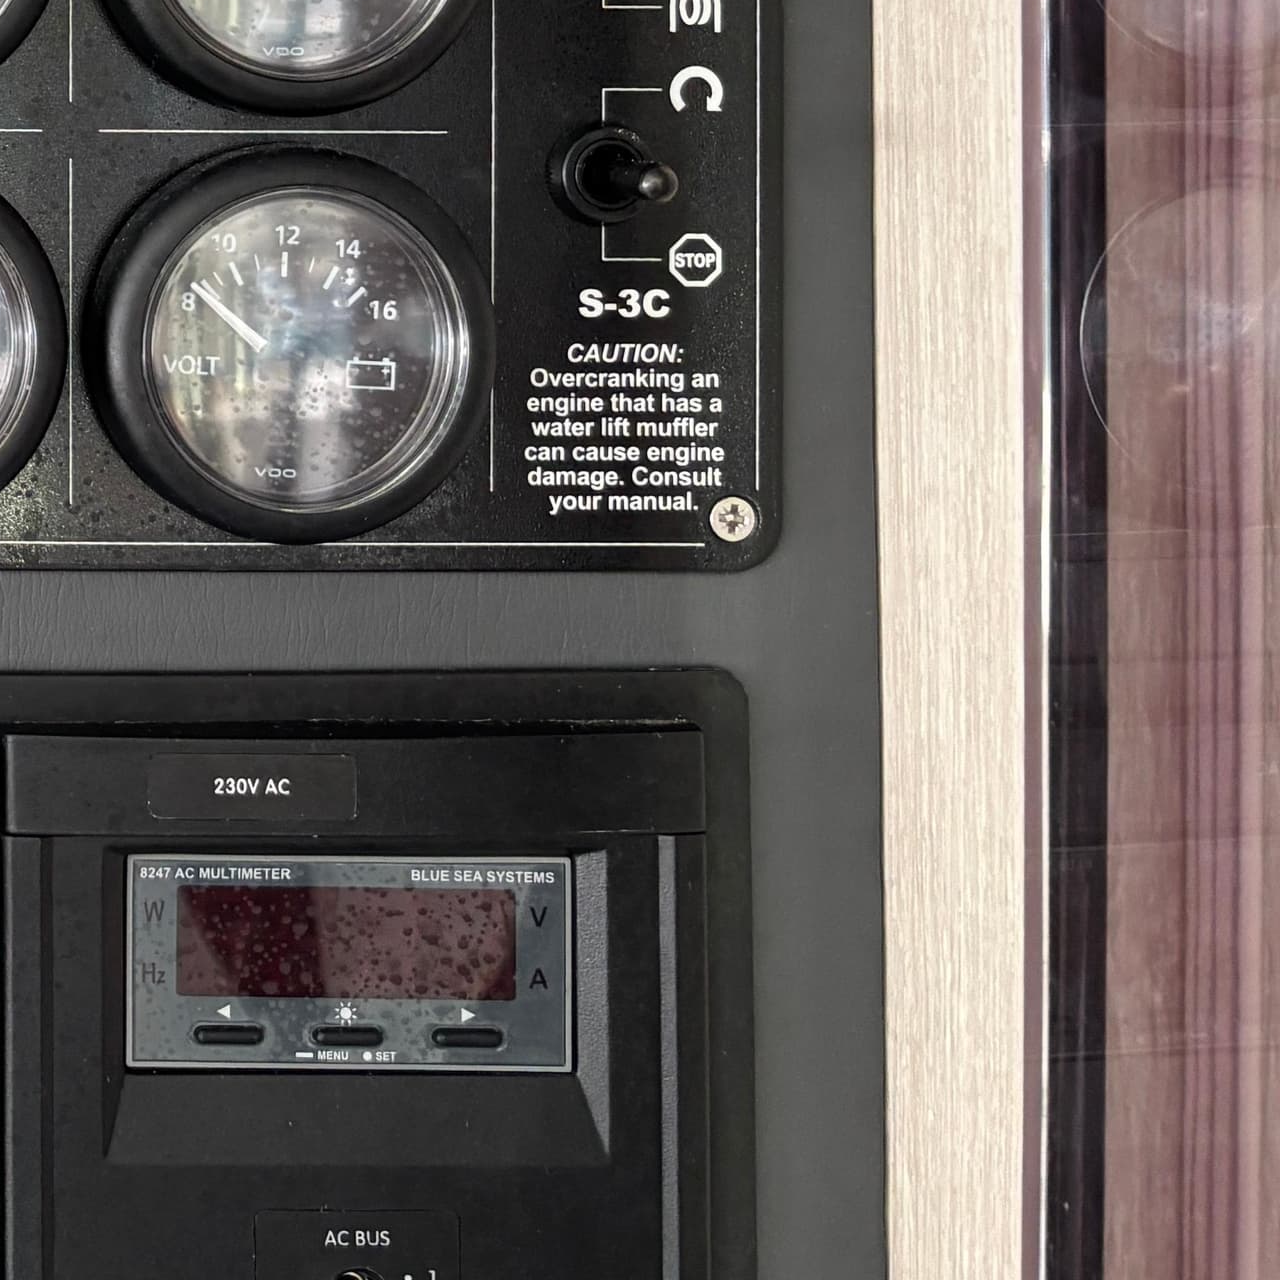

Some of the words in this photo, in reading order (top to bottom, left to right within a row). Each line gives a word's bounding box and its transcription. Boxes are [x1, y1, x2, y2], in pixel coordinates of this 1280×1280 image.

[212, 233, 236, 252] 10
[275, 225, 300, 245] 12
[333, 240, 360, 260] 14
[675, 253, 716, 269] STOP
[370, 301, 397, 320] 16
[579, 289, 670, 318] S-3C
[568, 344, 683, 363] CAUTION:
[163, 356, 220, 376] VOLT
[531, 368, 684, 392] Overcranking
[692, 373, 719, 388] an
[527, 393, 604, 416] engine
[611, 393, 655, 412] that
[662, 393, 702, 412] has
[709, 398, 722, 412] a
[532, 418, 594, 436] water
[602, 417, 630, 436] lift
[637, 417, 718, 437] muffler
[525, 447, 564, 461] can
[573, 447, 640, 461] cause
[647, 442, 724, 466] engine
[528, 467, 624, 490] damage.
[632, 466, 722, 486] Consult
[549, 496, 602, 515] your
[609, 491, 698, 510] manual.
[215, 778, 259, 794] 230V
[265, 779, 289, 794] AC
[140, 867, 171, 878] 8247
[175, 868, 194, 878] AC
[200, 868, 290, 879] MULTIMETER
[411, 870, 449, 881] BLUE
[454, 871, 482, 882] SEA
[487, 871, 554, 883] SYSTEMS
[318, 1051, 348, 1060] MENU
[376, 1052, 396, 1061] SET
[325, 1231, 348, 1245] AC
[356, 1231, 390, 1245] BUS
